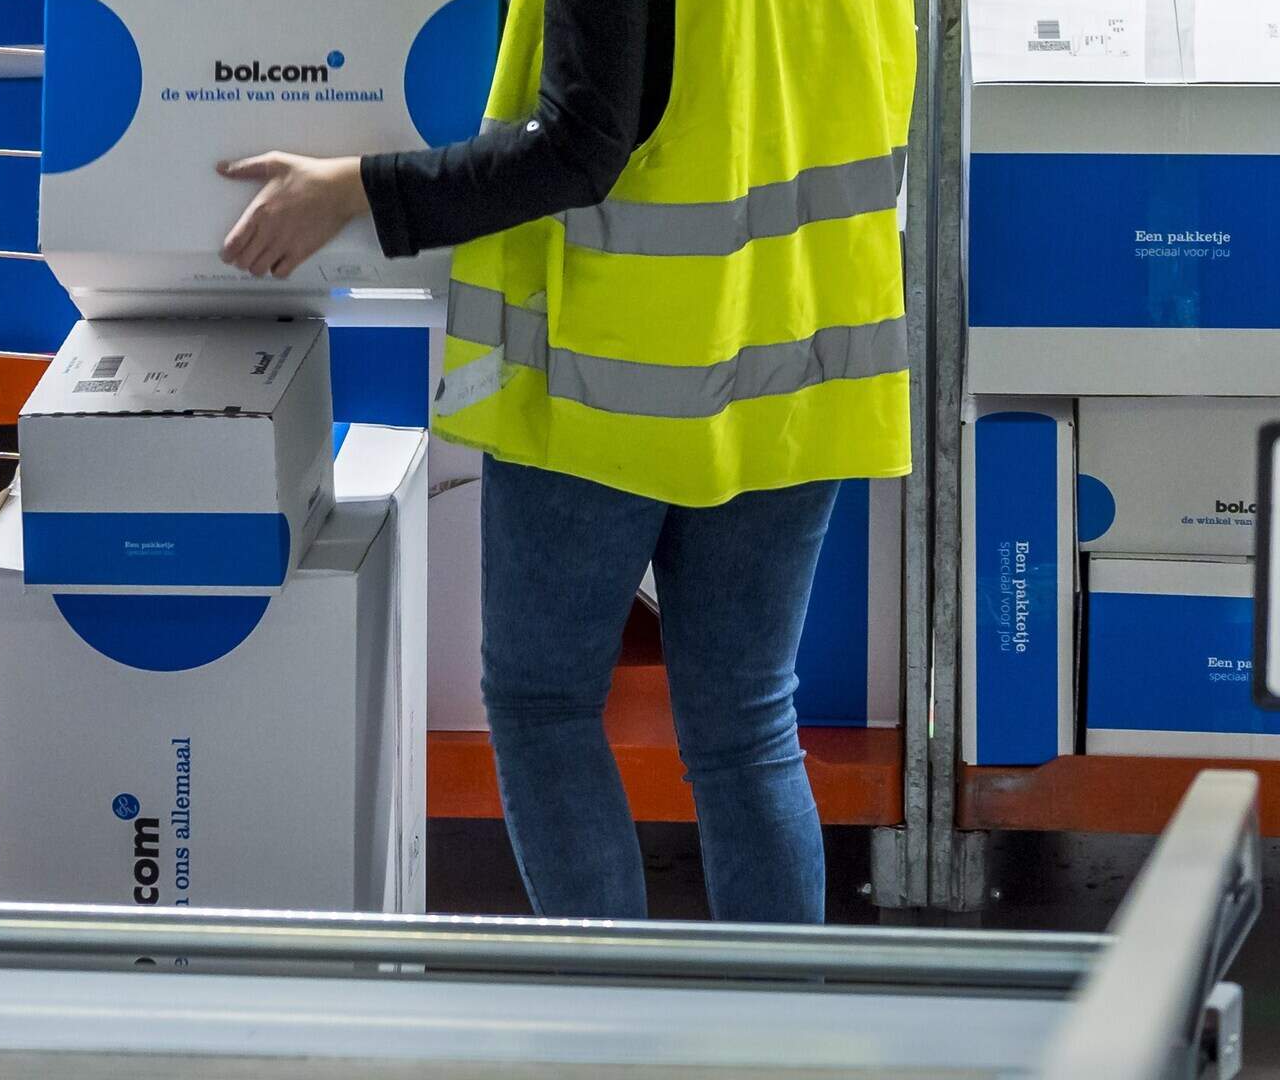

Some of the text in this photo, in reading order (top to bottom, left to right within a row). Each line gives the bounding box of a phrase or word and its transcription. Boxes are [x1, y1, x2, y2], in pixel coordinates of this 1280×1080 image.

[214, 60, 329, 83] bol.com
[161, 88, 384, 102] de winkel van ons allemaal
[1134, 230, 1231, 245] Een pakketje
[1135, 246, 1231, 260] speciaal voor jou
[1215, 499, 1257, 514] bol.c
[1180, 516, 1253, 526] de winkel van
[996, 541, 1012, 652] speciaal voor jou
[1012, 541, 1029, 652] Een pakketje
[1207, 657, 1233, 668] Een
[1209, 671, 1249, 682] speciaal
[171, 737, 190, 890] ons allemaal
